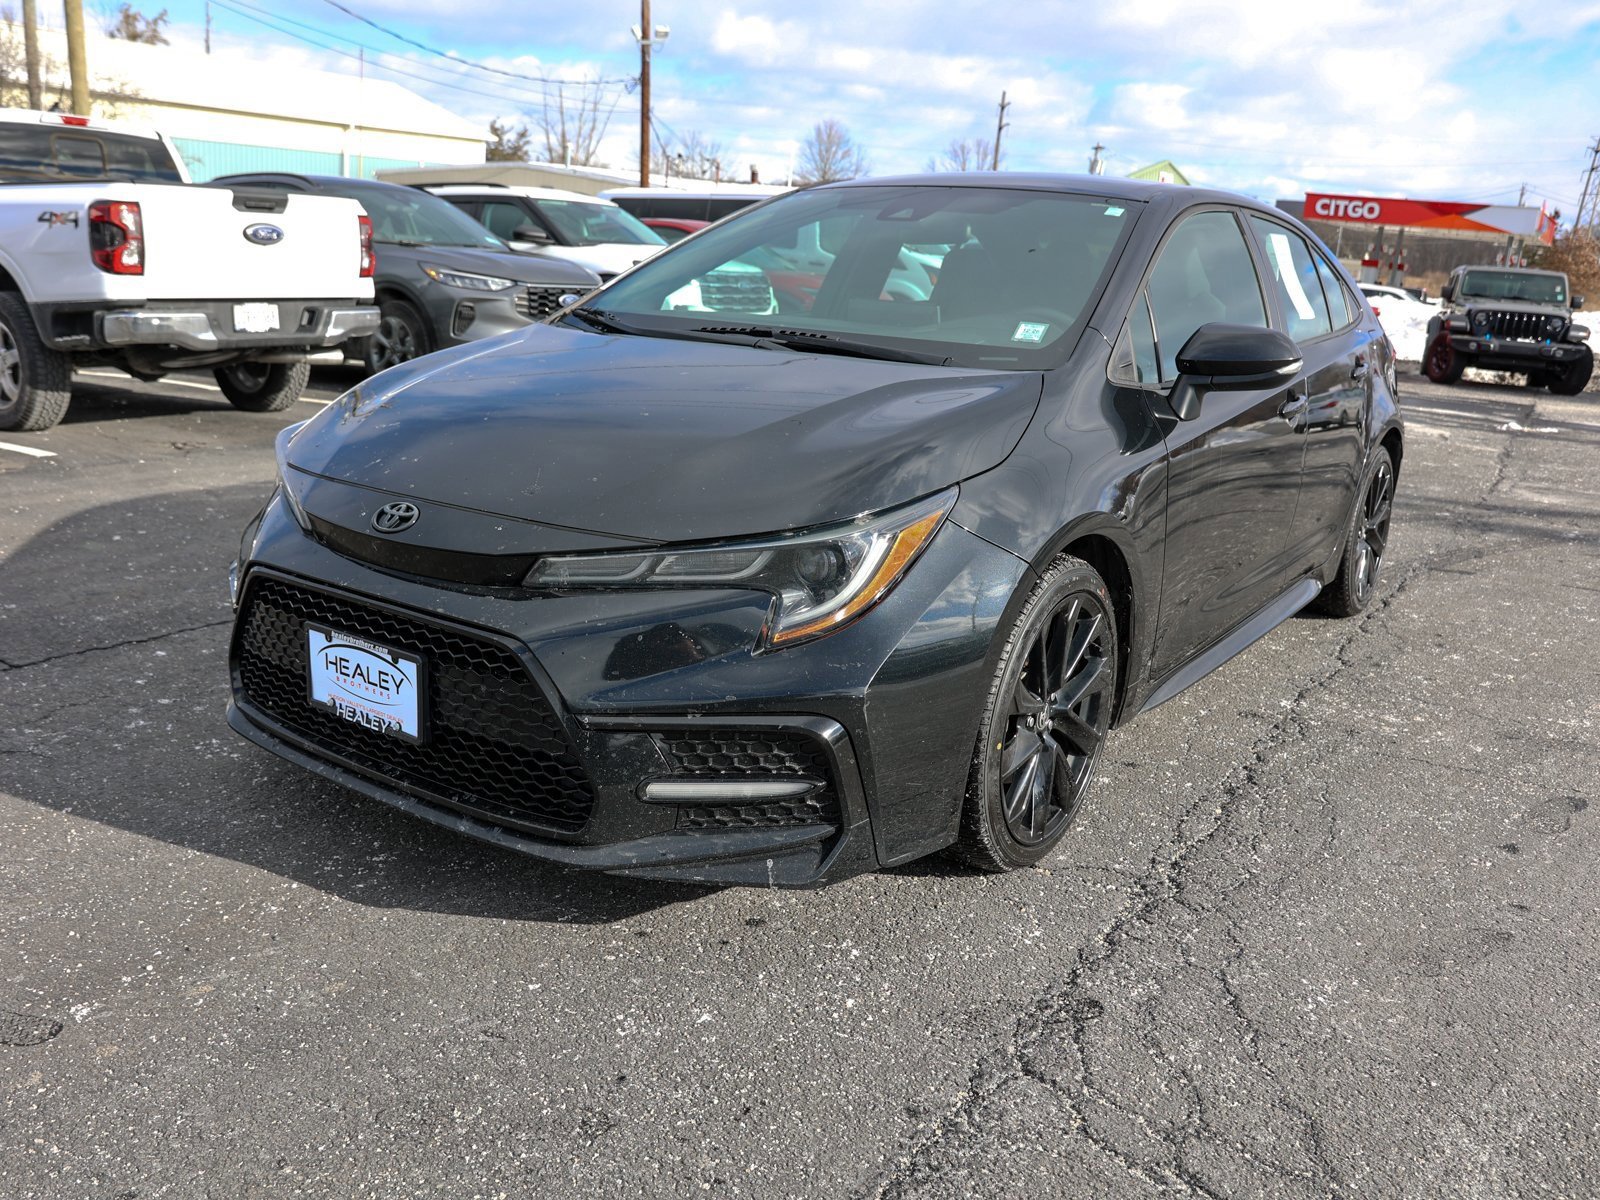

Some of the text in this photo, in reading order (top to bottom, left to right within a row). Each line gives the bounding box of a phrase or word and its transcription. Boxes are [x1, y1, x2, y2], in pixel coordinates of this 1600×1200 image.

[1315, 198, 1380, 219] CITGO
[325, 652, 404, 695] HEALEY
[336, 675, 391, 700] BROTHERS
[337, 703, 389, 733] HEALEY
